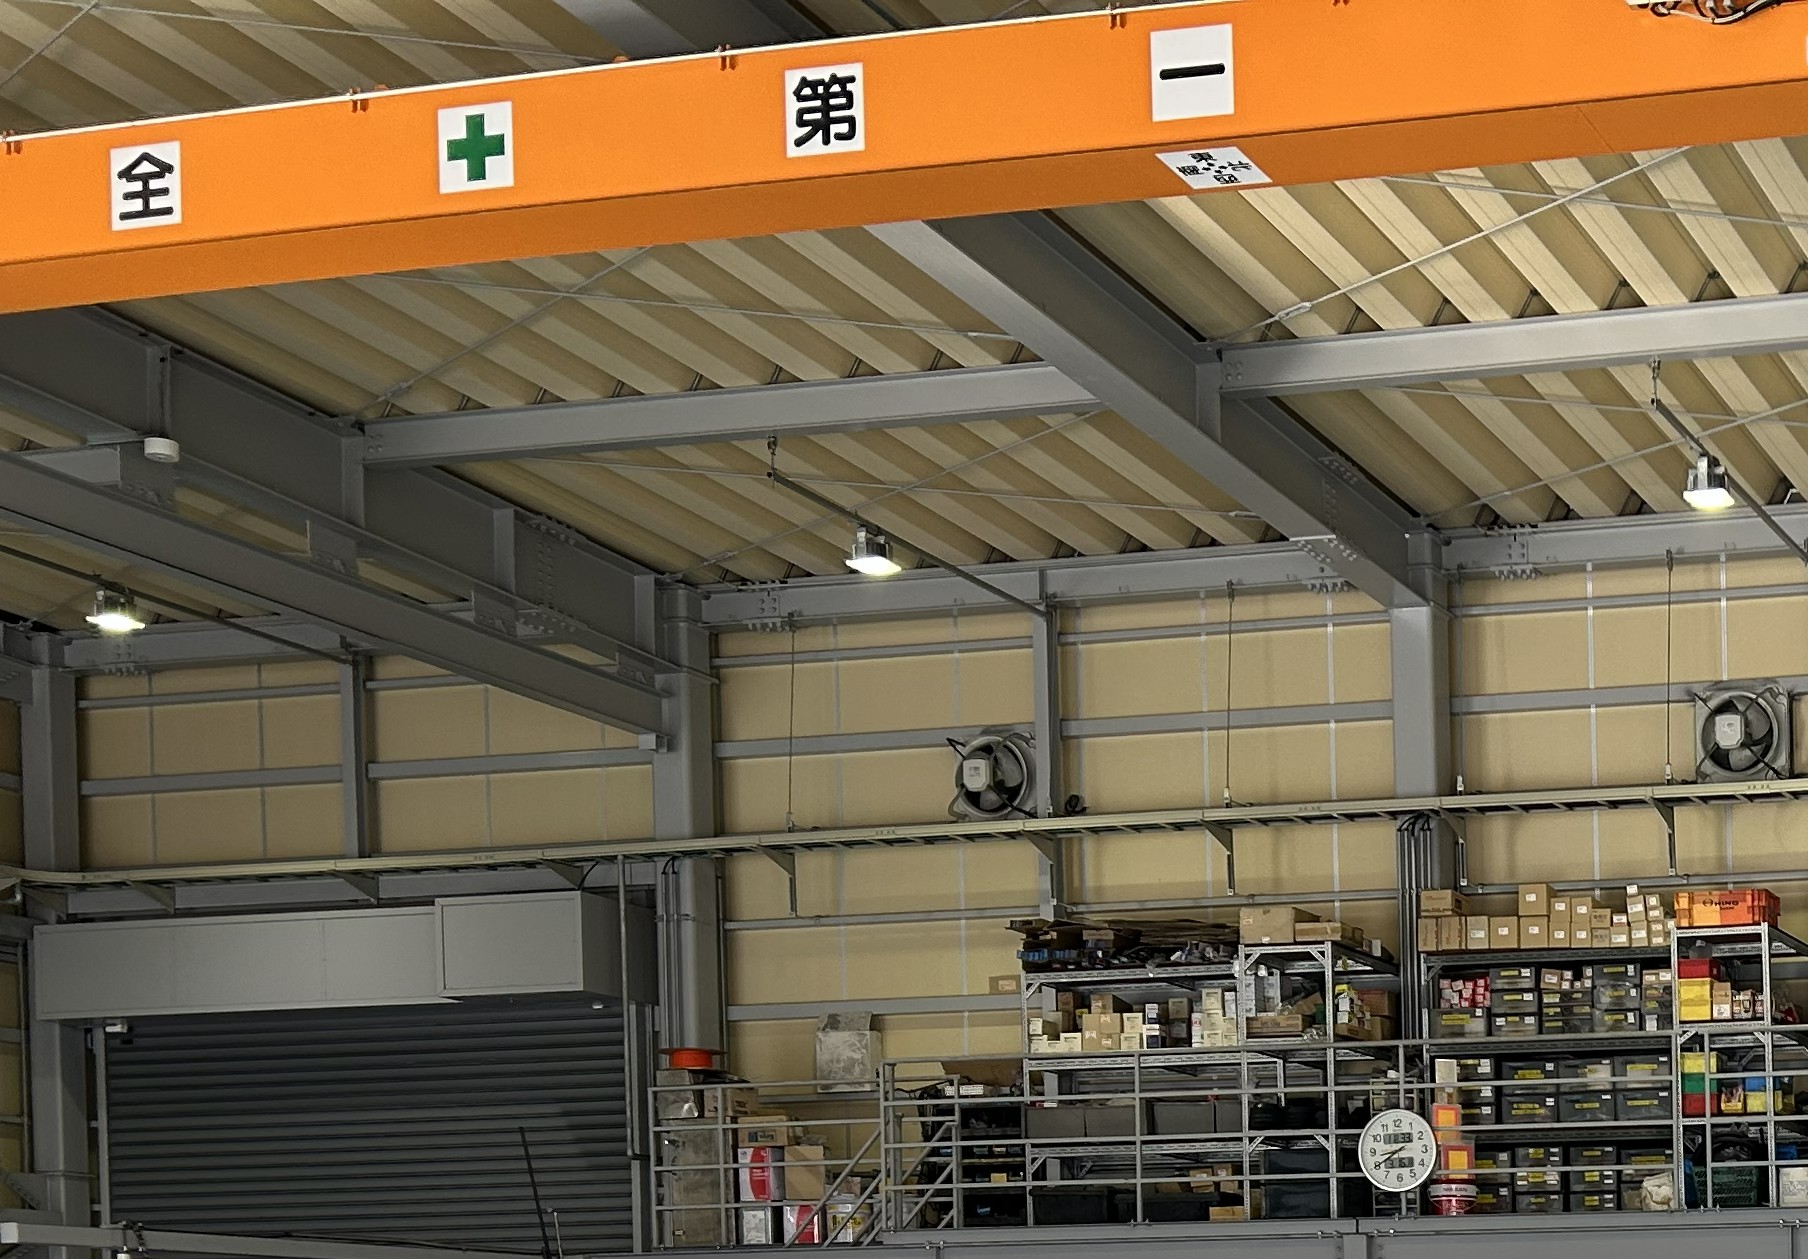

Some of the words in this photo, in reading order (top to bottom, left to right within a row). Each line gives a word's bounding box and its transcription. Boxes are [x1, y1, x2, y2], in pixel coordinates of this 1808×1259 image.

[117, 151, 174, 222] 全
[792, 73, 858, 148] 第
[1714, 899, 1740, 907] HINO
[1380, 1123, 1389, 1133] 11
[1393, 1118, 1402, 1128] 12
[1408, 1121, 1414, 1131] 1
[1417, 1131, 1424, 1141] 2
[1369, 1147, 1377, 1157] 9
[1421, 1144, 1428, 1154] 3
[1418, 1158, 1425, 1168] 4
[1384, 1170, 1391, 1180] 7
[1396, 1173, 1404, 1183] 6
[1409, 1168, 1417, 1178] 5
